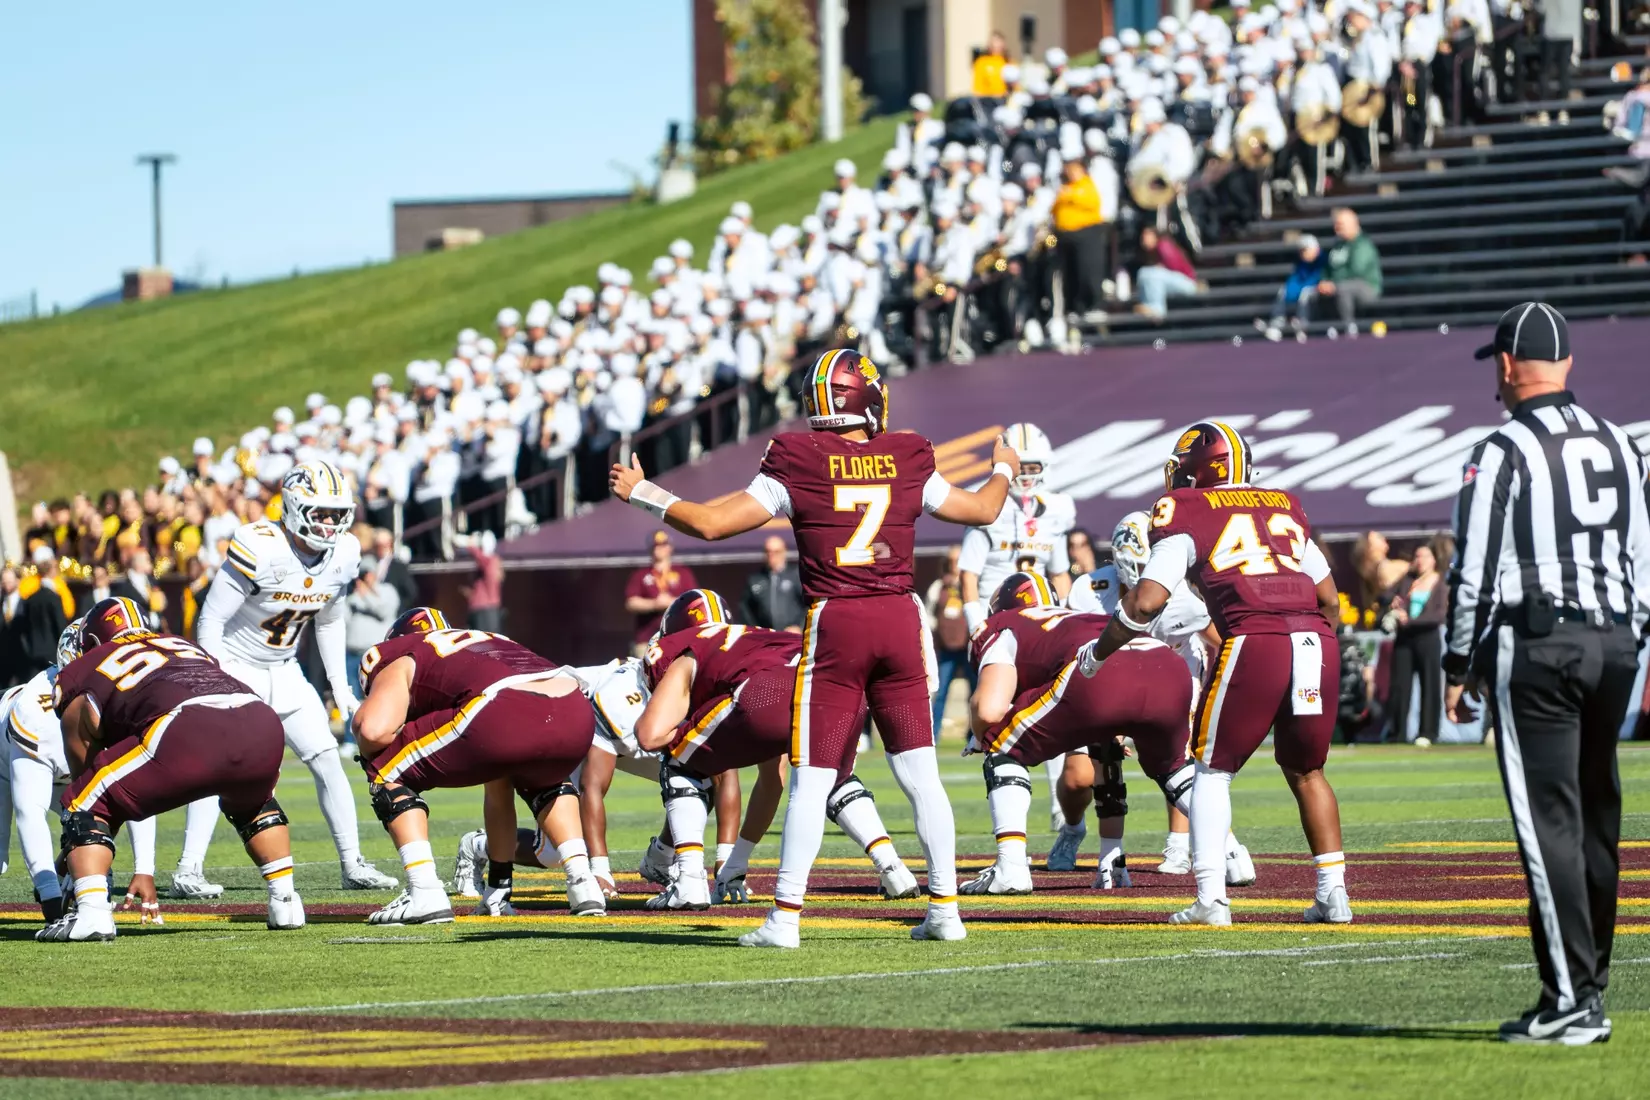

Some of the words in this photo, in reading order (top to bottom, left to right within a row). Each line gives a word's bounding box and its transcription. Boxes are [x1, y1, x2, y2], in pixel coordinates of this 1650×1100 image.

[810, 417, 846, 427] RESPECT
[829, 454, 897, 479] FLORES
[1561, 437, 1619, 526] C
[1148, 496, 1176, 531] 3
[1203, 490, 1291, 511] WOODFORD
[833, 484, 891, 566] 7
[1208, 513, 1306, 575] 43
[272, 591, 333, 604] BRONCOS
[259, 608, 320, 648] 47
